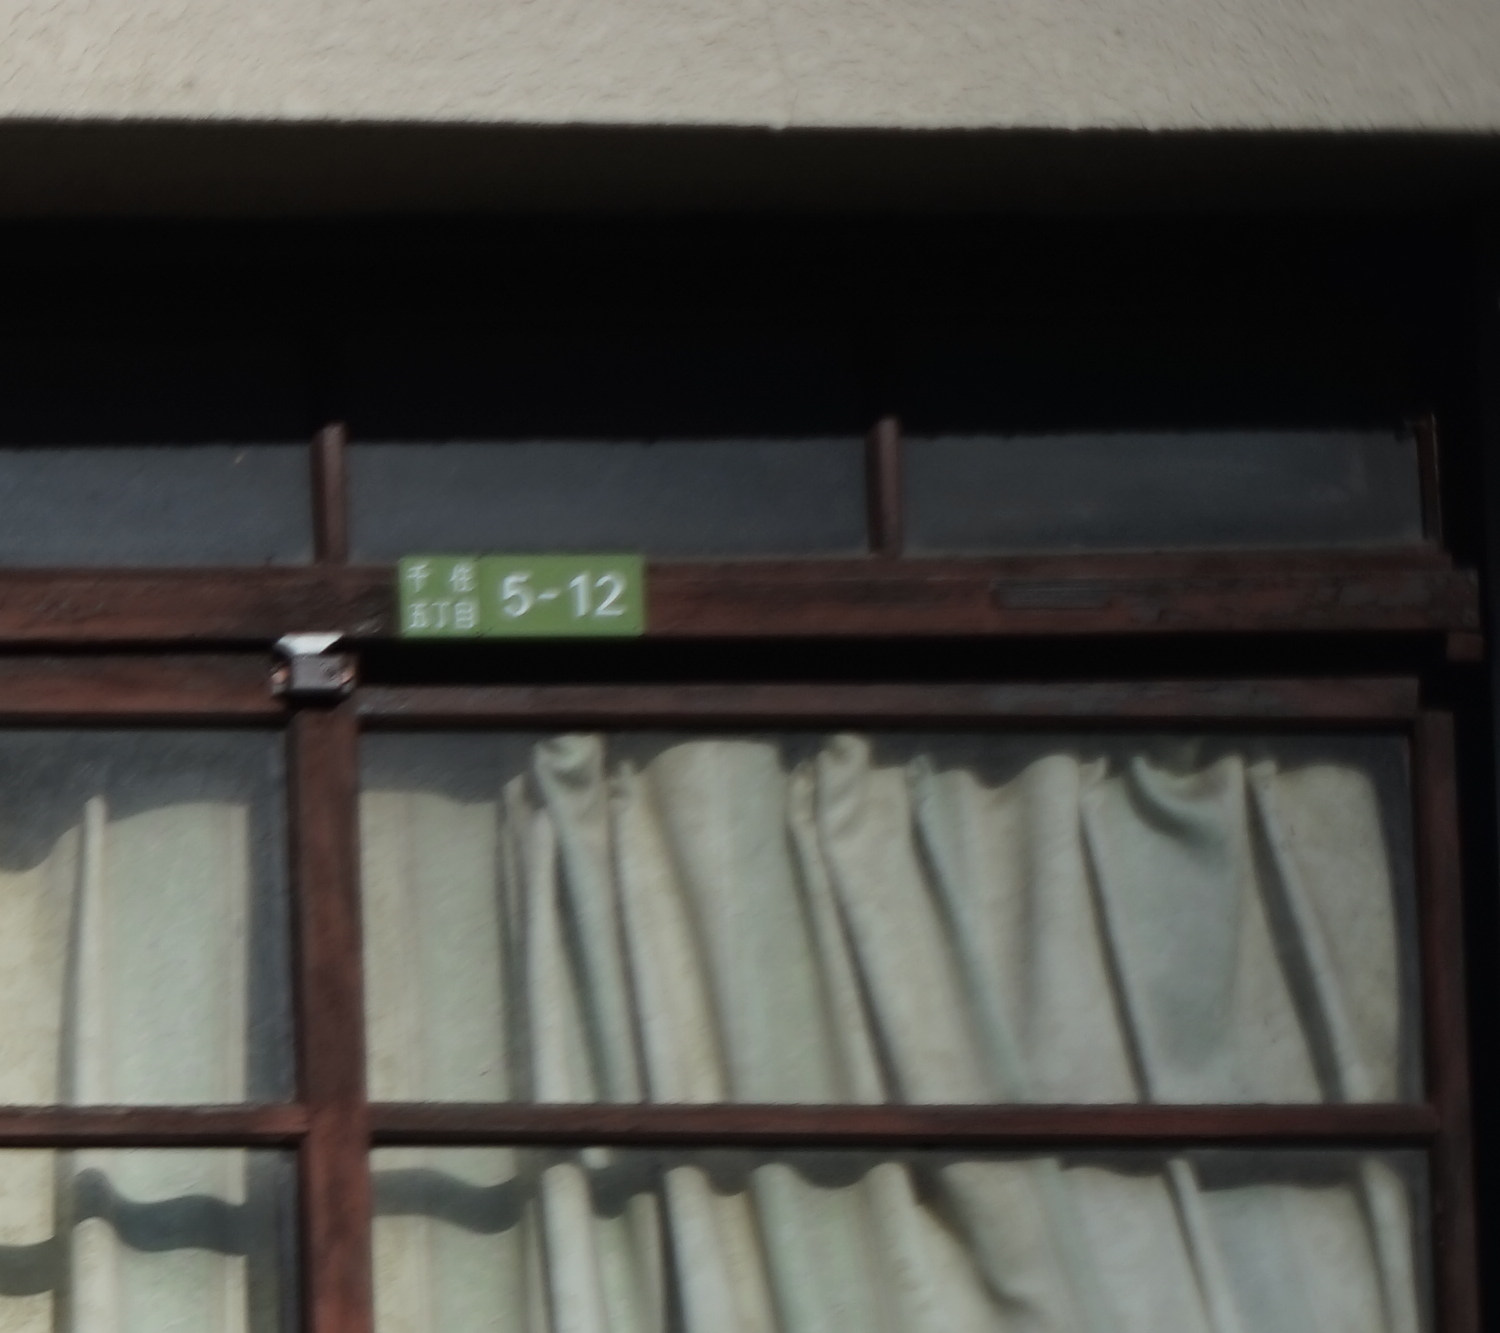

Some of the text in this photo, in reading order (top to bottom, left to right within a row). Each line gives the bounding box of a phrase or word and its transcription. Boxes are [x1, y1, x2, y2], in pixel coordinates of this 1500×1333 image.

[501, 570, 628, 618] 5-12
[407, 601, 477, 630] 五丁目
